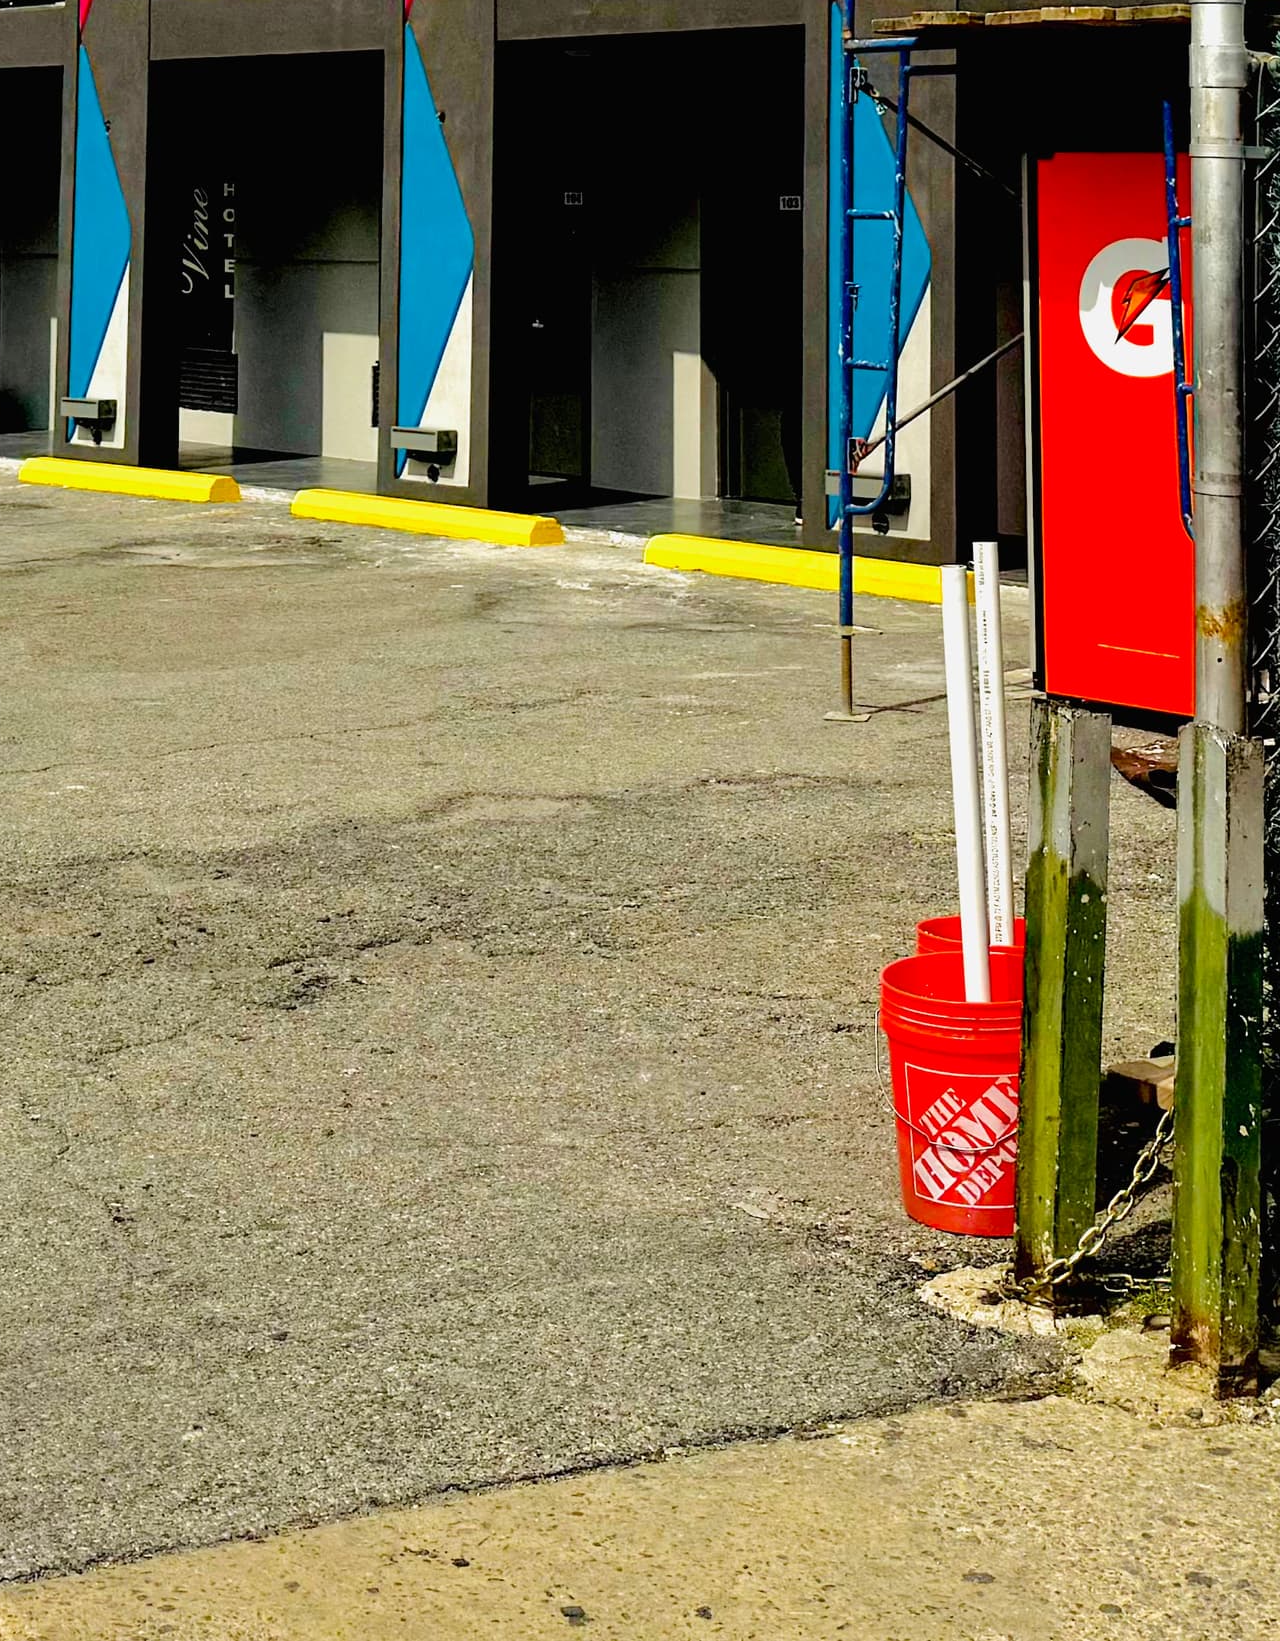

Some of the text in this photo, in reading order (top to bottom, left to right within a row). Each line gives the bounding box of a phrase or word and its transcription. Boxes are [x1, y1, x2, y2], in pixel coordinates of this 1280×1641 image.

[181, 185, 209, 294] Vine
[223, 182, 236, 299] HOTEL
[1078, 237, 1184, 378] G
[914, 1076, 1018, 1200] HOME
[918, 1087, 967, 1137] THE
[955, 1139, 1018, 1205] DEPO
